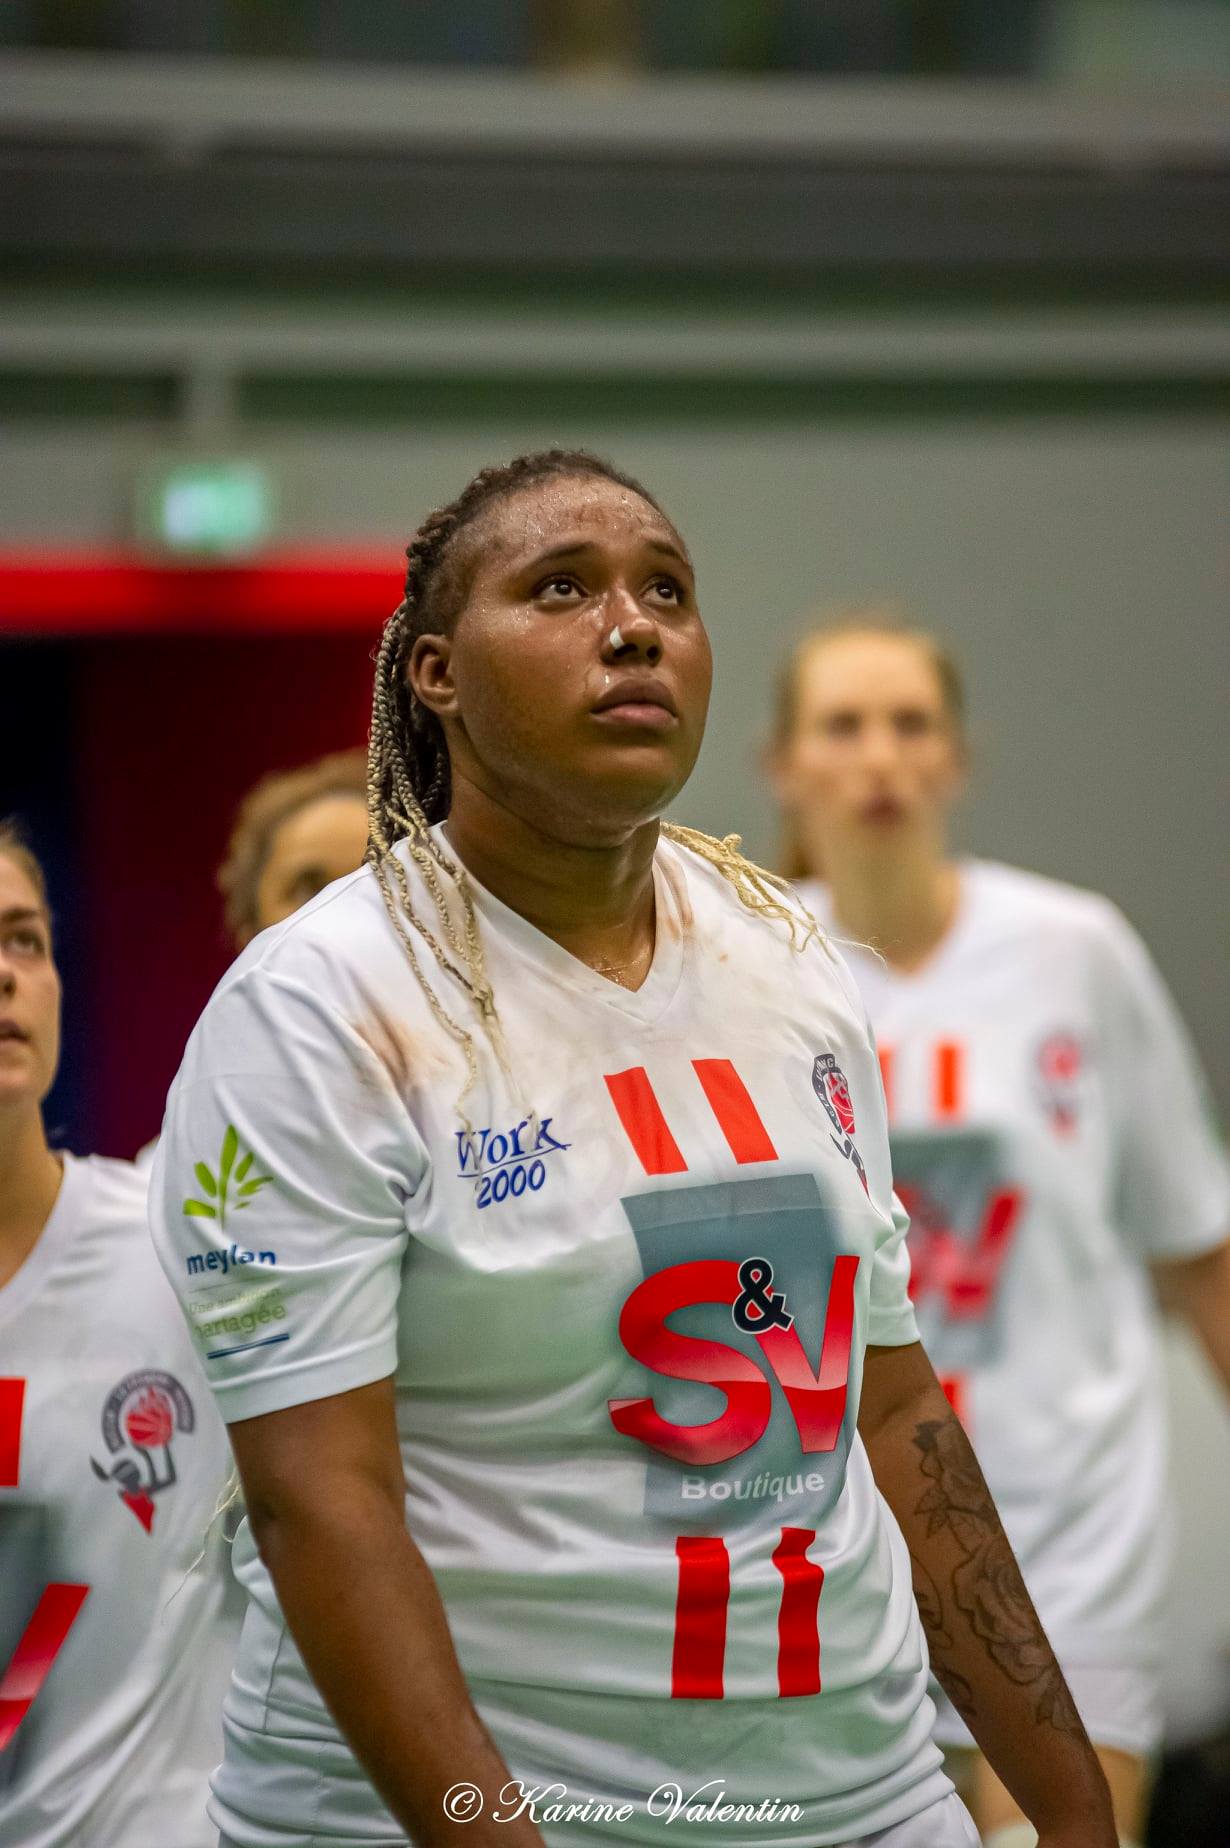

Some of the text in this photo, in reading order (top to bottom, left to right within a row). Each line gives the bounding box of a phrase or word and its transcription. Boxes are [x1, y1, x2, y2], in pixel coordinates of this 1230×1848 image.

[455, 1114, 572, 1171] Work
[476, 1159, 546, 1209] 2000
[186, 1244, 277, 1275] meylan
[680, 1470, 825, 1502] Boutique
